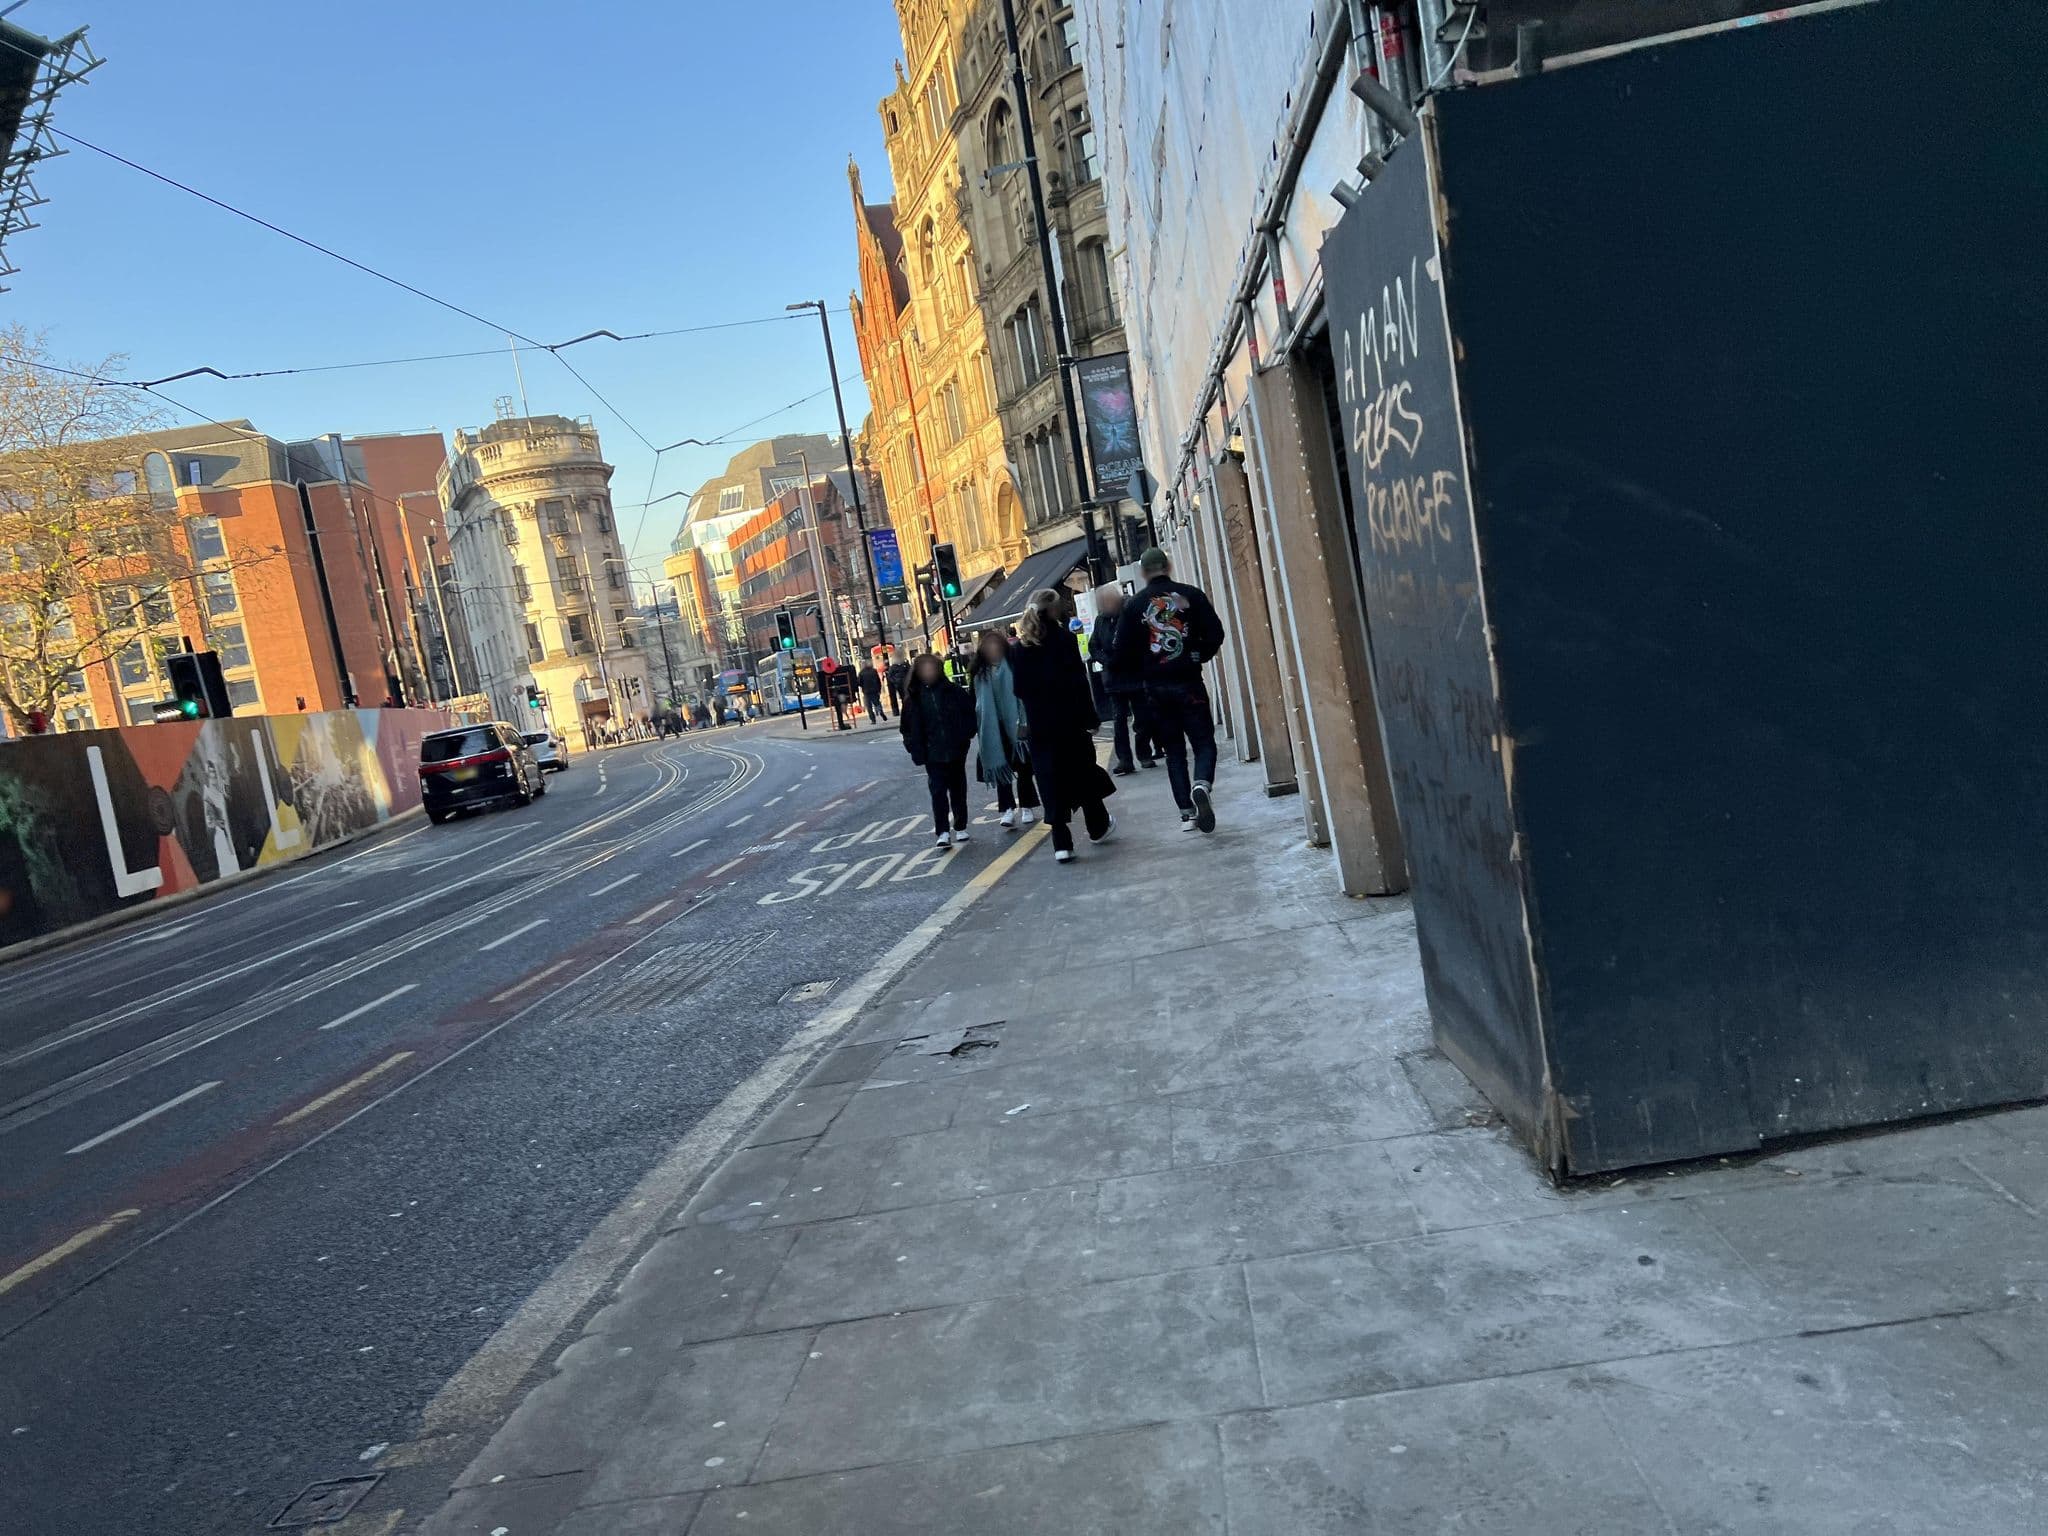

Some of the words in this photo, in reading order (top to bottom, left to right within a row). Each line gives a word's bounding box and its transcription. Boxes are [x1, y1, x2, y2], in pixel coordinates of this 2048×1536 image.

[1344, 328, 1356, 402] A
[1360, 256, 1419, 400] MAN
[756, 840, 970, 905] BUS
